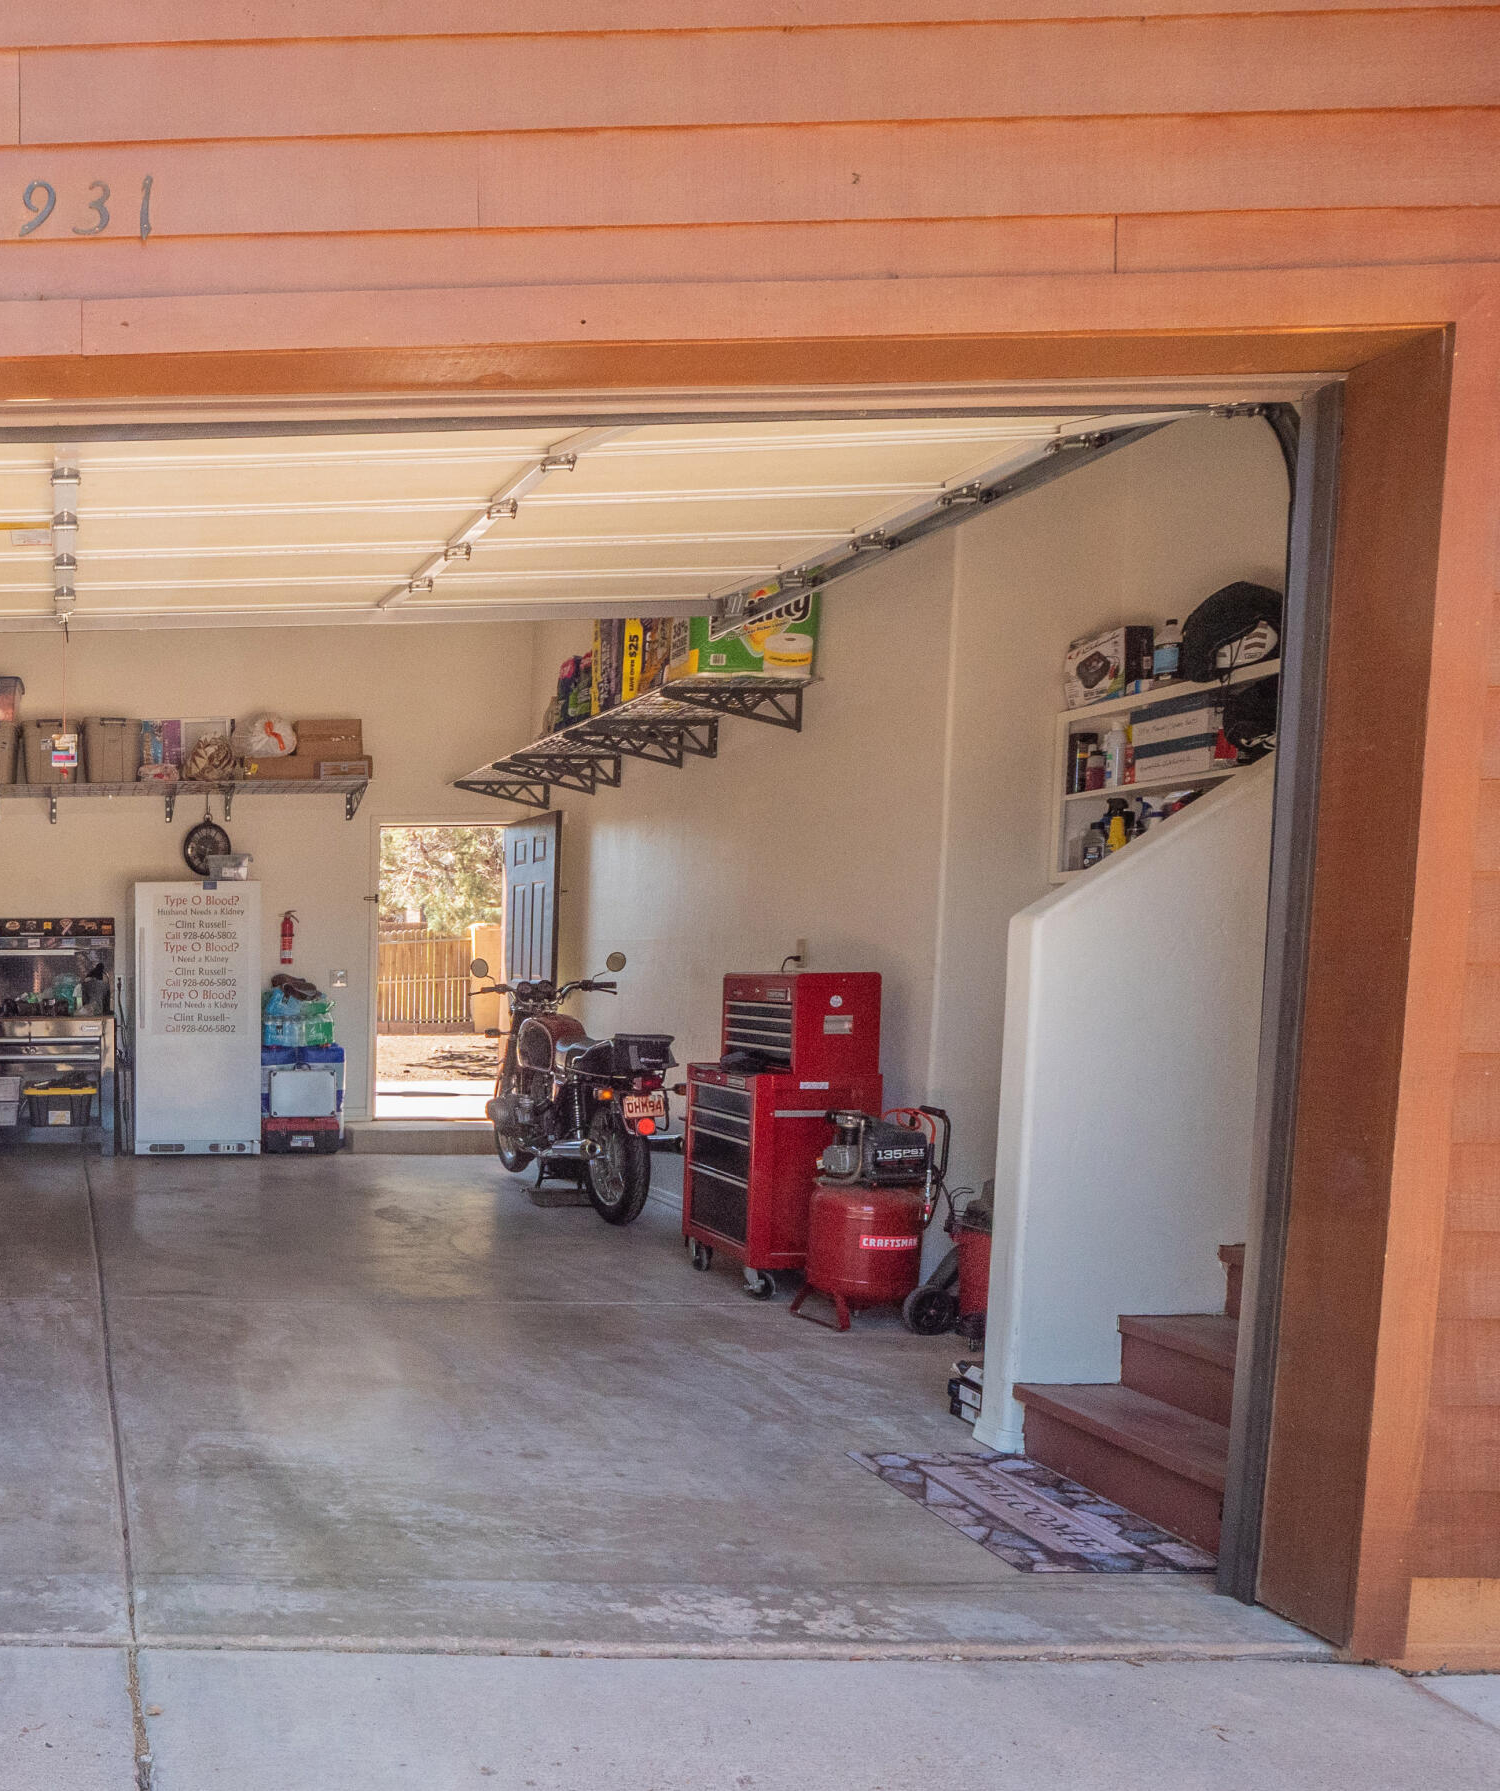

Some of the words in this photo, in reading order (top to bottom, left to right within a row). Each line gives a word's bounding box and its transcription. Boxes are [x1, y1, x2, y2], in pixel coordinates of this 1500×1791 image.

[628, 635, 639, 657] $25
[164, 895, 188, 907] Type
[191, 895, 202, 905] O
[205, 895, 240, 906] Blood?
[157, 908, 187, 916] Husband
[220, 908, 245, 916] Kidney
[164, 942, 187, 953] Type
[191, 942, 201, 952] O
[205, 942, 240, 952] Blood?
[204, 955, 229, 964] Kidney
[165, 978, 181, 986] Call
[182, 978, 237, 986] 928-606-5802
[161, 989, 185, 1000] Type
[188, 989, 199, 999] O
[202, 989, 237, 1000] Blood?
[160, 1001, 182, 1009] Friend
[184, 1001, 205, 1009] Needs
[214, 1001, 239, 1009] Kidney
[955, 1471, 1104, 1548] WELCOME
